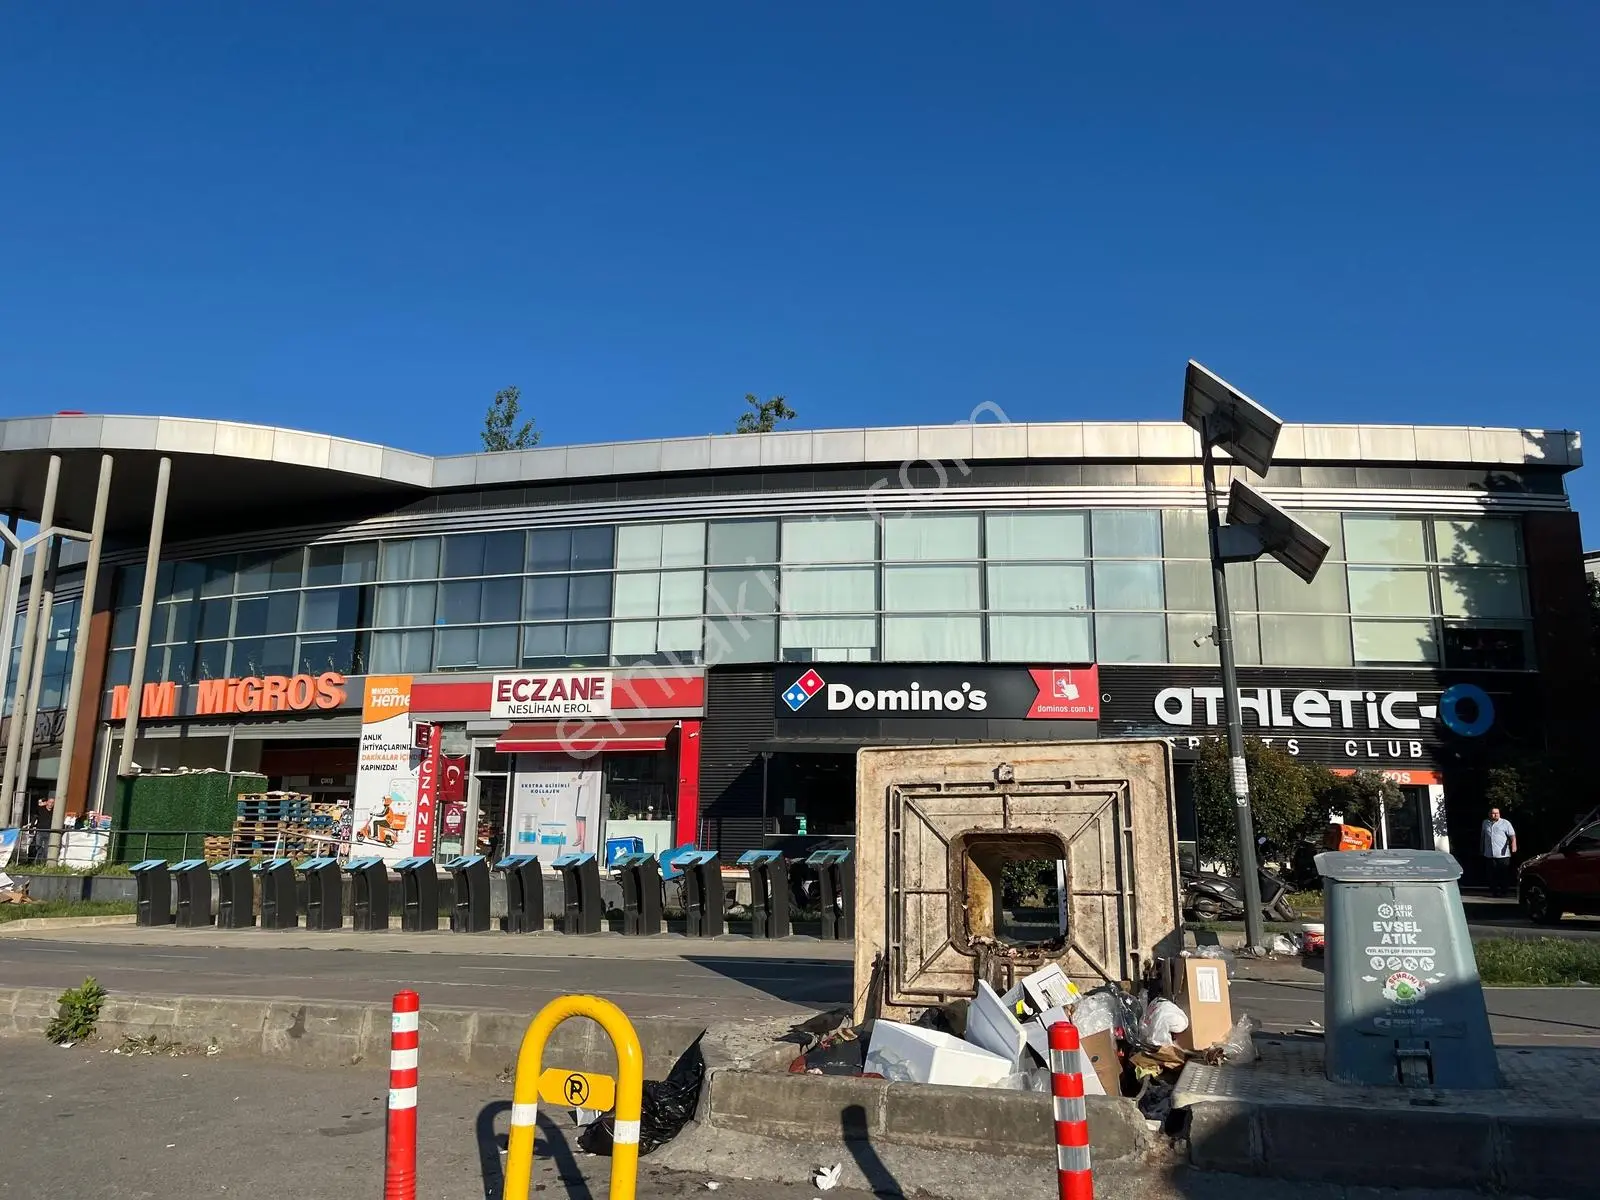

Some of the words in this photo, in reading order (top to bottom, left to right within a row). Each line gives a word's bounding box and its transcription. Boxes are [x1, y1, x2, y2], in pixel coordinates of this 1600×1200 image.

[497, 678, 605, 702] ECZANE
[827, 681, 988, 711] Domino's
[508, 703, 561, 714] NESLİHAN
[564, 704, 592, 713] EROL
[1037, 705, 1094, 713] dominos.com.tr
[1345, 741, 1422, 758] CLUB
[1373, 921, 1422, 932] EVSEL
[1381, 933, 1417, 944] ATIK
